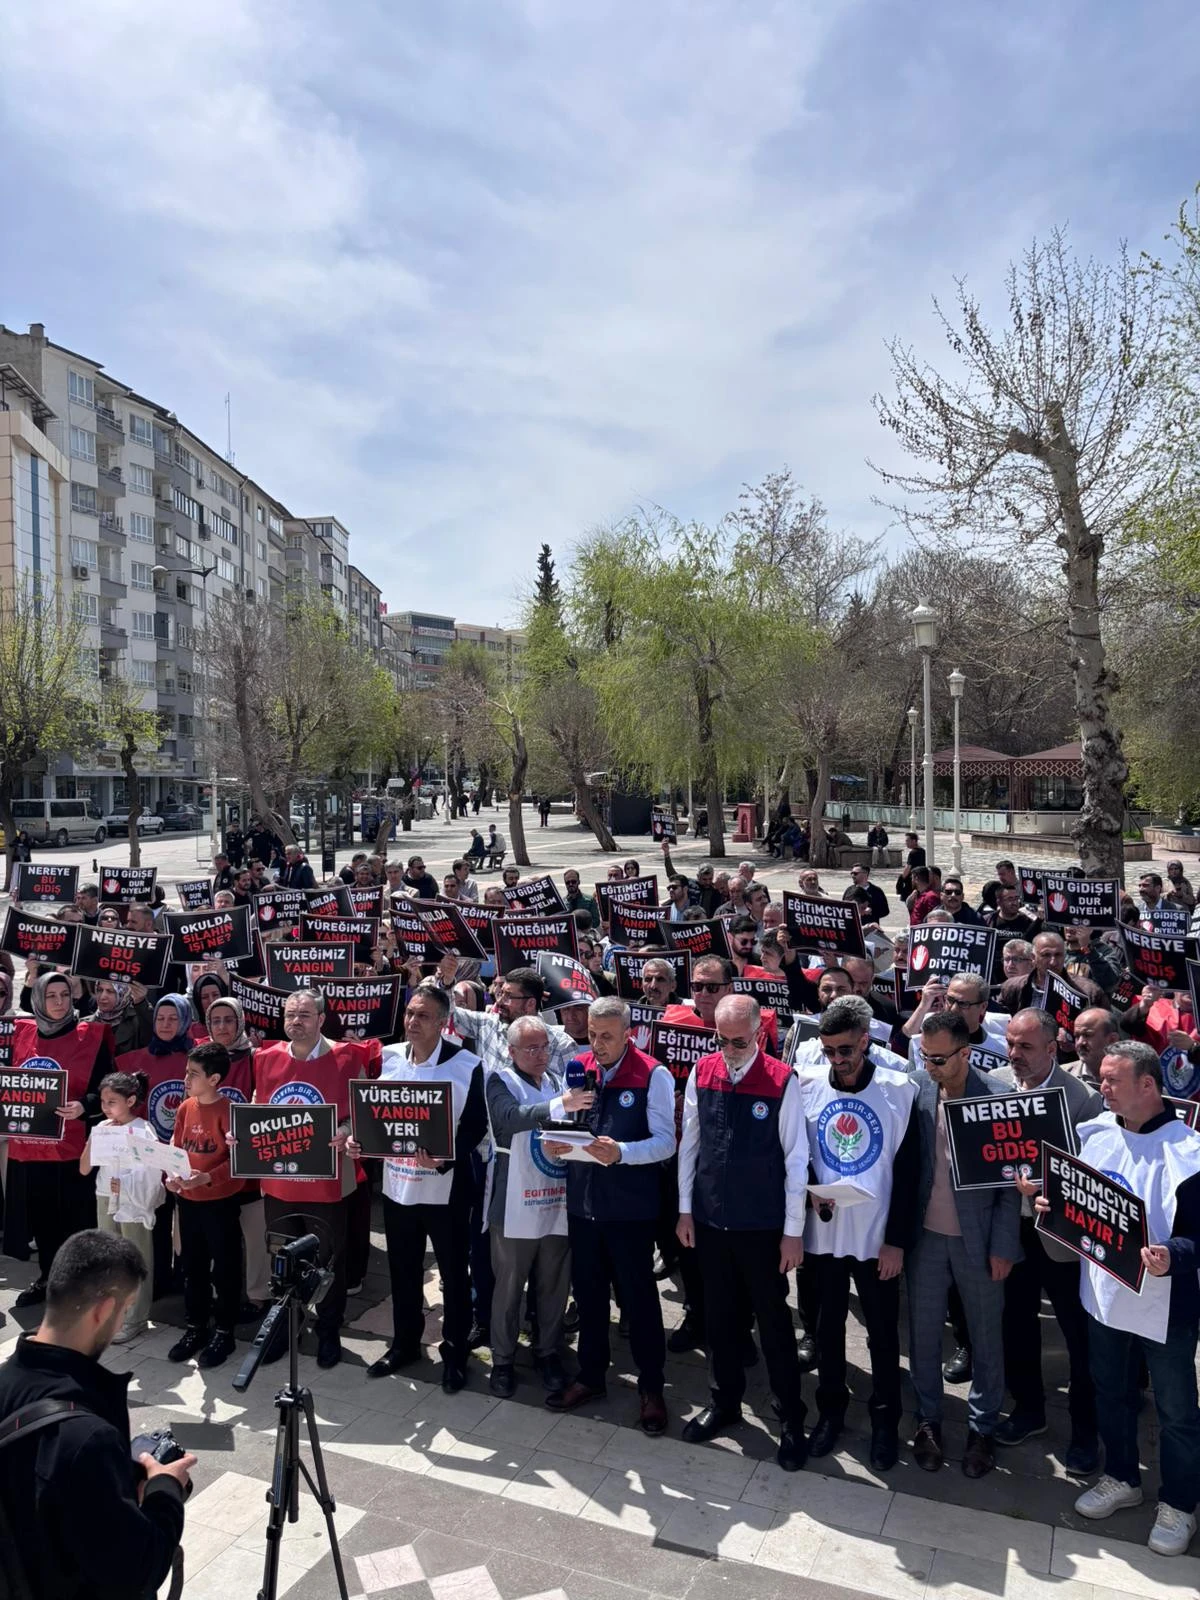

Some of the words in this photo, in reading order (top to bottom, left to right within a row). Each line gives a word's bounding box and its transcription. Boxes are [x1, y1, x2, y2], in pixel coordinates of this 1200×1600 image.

[28, 866, 70, 877] NEREYE
[104, 869, 118, 878] BU
[1021, 870, 1034, 878] BU
[41, 876, 56, 885] BU
[129, 880, 145, 888] DUR
[1047, 879, 1064, 891] BU
[189, 892, 202, 900] DUR
[258, 894, 273, 904] BU
[351, 890, 380, 901] EĞİMİZ
[504, 889, 517, 900] BU
[529, 893, 546, 904] DUR
[1078, 897, 1101, 906] DUR
[459, 906, 499, 919] EĞİMİZ
[1139, 911, 1151, 920] BU
[18, 922, 67, 935] OKULDA
[180, 914, 233, 935] OKULDA
[393, 916, 426, 931] YÜREĞİ
[467, 918, 488, 929] GIN
[618, 916, 657, 929] YANGIN
[315, 932, 361, 943] YANGIN
[671, 924, 710, 940] OKULDA
[800, 926, 838, 940] HAYIR
[913, 927, 929, 944] BU
[38, 942, 61, 951] NE?
[91, 930, 158, 950] NEREYE
[207, 934, 232, 948] NE?
[511, 936, 559, 948] YANGIN
[1124, 928, 1185, 953] NEREYE
[111, 947, 134, 960] BU
[522, 949, 541, 960] YE
[941, 945, 969, 960] DUR
[1141, 949, 1162, 964] BU
[284, 962, 334, 973] YANGIN
[294, 975, 312, 986] YE
[733, 981, 753, 992] BU
[870, 984, 895, 993] KUL
[1053, 979, 1081, 1009] NEREYE
[327, 998, 381, 1011] YANGIN
[768, 996, 790, 1007] DUR
[244, 1012, 269, 1028] AYIR
[631, 1008, 652, 1023] BU
[657, 1029, 720, 1052] EĞİTİMCİ
[666, 1046, 709, 1063] ŞİDD
[969, 1050, 1007, 1070] REY
[0, 1073, 58, 1090] REĞİMİZ
[0, 1090, 47, 1104] ANGIN
[371, 1105, 431, 1120] YANGIN
[962, 1096, 1047, 1123] NEREYE
[250, 1111, 314, 1135] OKULDA
[992, 1120, 1023, 1141] BU
[281, 1139, 312, 1157] NE?
[523, 1186, 566, 1198] EĞİTİM-B
[1064, 1201, 1113, 1246] HAYIR
